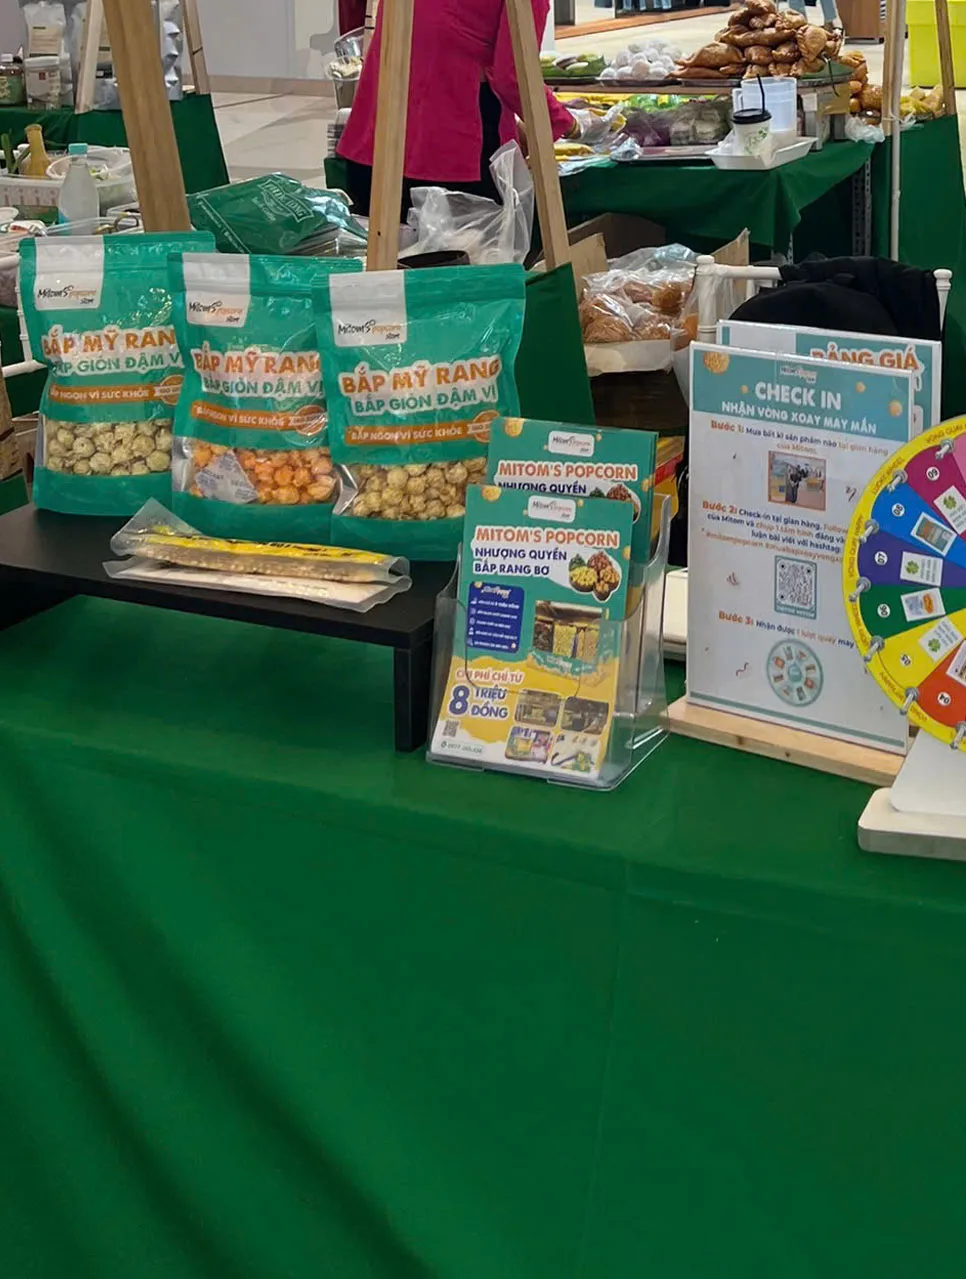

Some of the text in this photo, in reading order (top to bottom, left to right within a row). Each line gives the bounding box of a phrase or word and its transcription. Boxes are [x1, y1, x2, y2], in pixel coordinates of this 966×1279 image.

[125, 327, 175, 350] RAN
[879, 346, 920, 370] GIÁ
[341, 358, 500, 394] BẮP MỸ RANG
[355, 393, 385, 414] BẮP
[437, 386, 477, 408] ĐẬM
[755, 382, 841, 410] CHECK IN
[722, 400, 754, 418] NHẬN
[757, 406, 788, 421] VÒNG
[791, 412, 821, 426] XOAY
[824, 417, 848, 430] MAY
[499, 462, 637, 480] MITOM'S POPCORN
[476, 527, 618, 547] MITOM'S POPCORN
[475, 546, 567, 560] NHƯỢNG QUYỀN
[500, 563, 531, 575] RANG
[449, 685, 470, 715] 8
[471, 701, 508, 718] ĐỒNG
